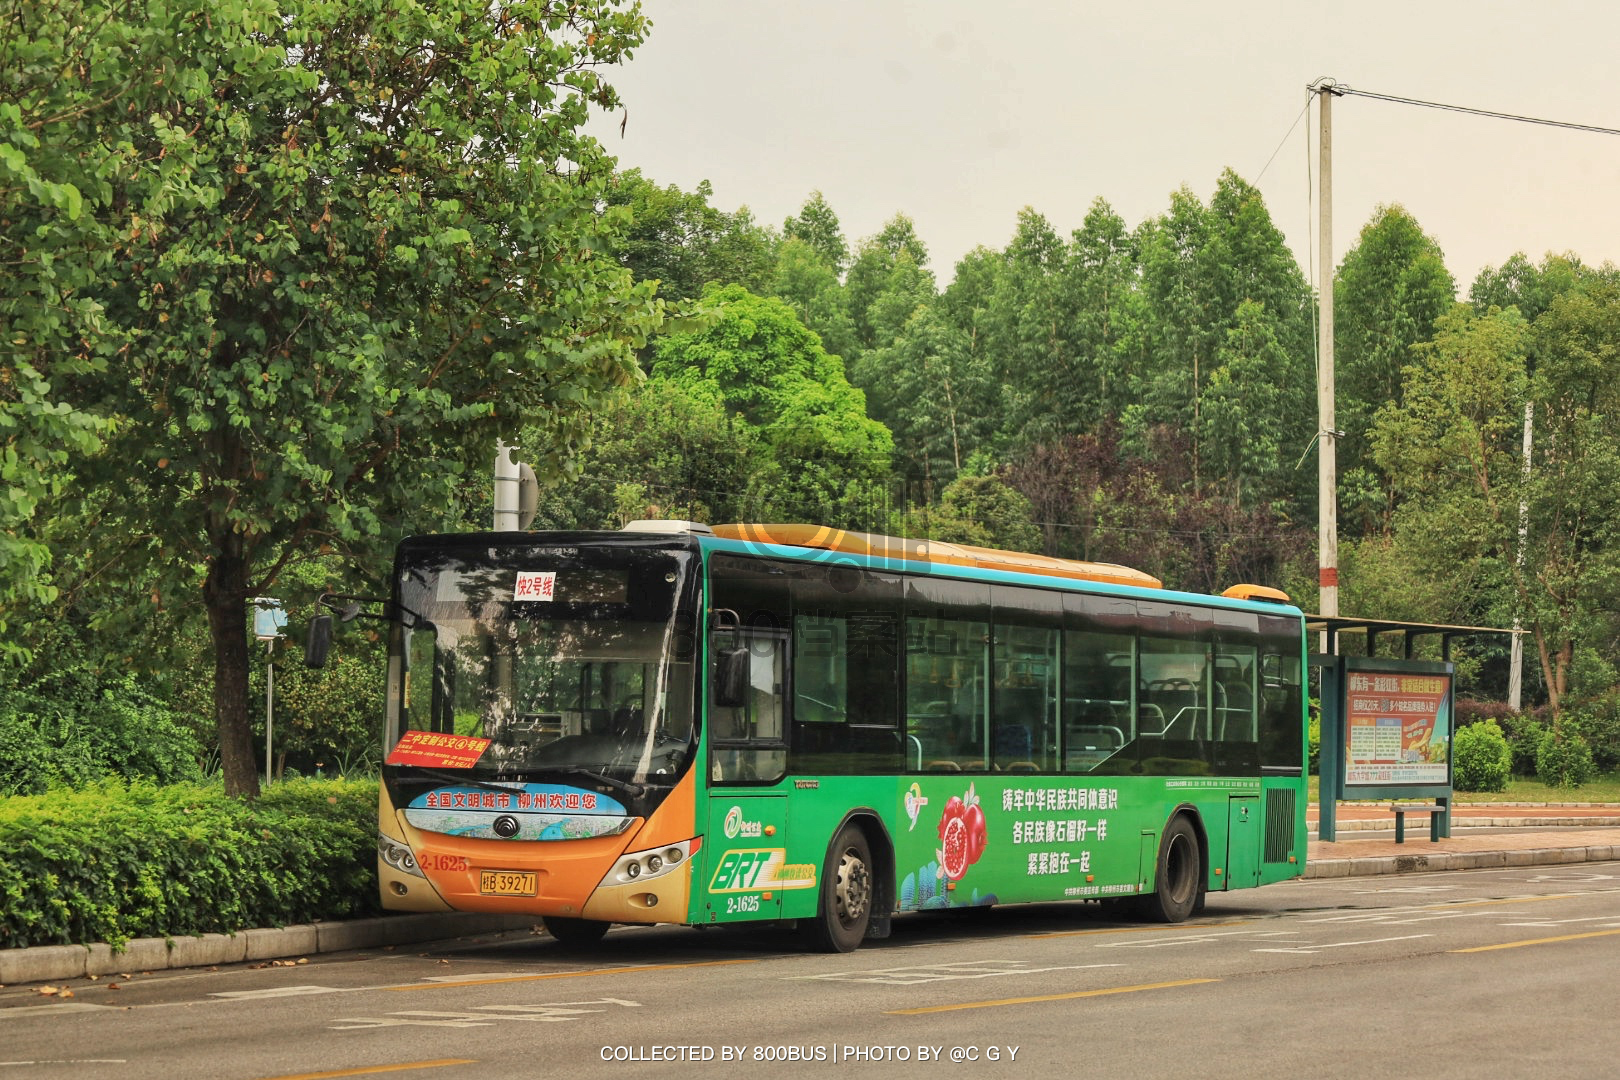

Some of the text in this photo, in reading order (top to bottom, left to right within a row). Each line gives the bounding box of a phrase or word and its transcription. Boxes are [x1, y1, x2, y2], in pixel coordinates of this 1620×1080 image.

[517, 576, 553, 597] 快2号线
[426, 792, 597, 809] 全国文明城市 柳州欢迎您
[1002, 788, 1118, 812] 铸牢中华民族共同体意识
[1012, 819, 1108, 844] 各民族像石榴籽一样
[421, 854, 467, 872] 2-1625
[711, 852, 773, 890] BRT
[1027, 851, 1091, 876] 紧紧抱在一起
